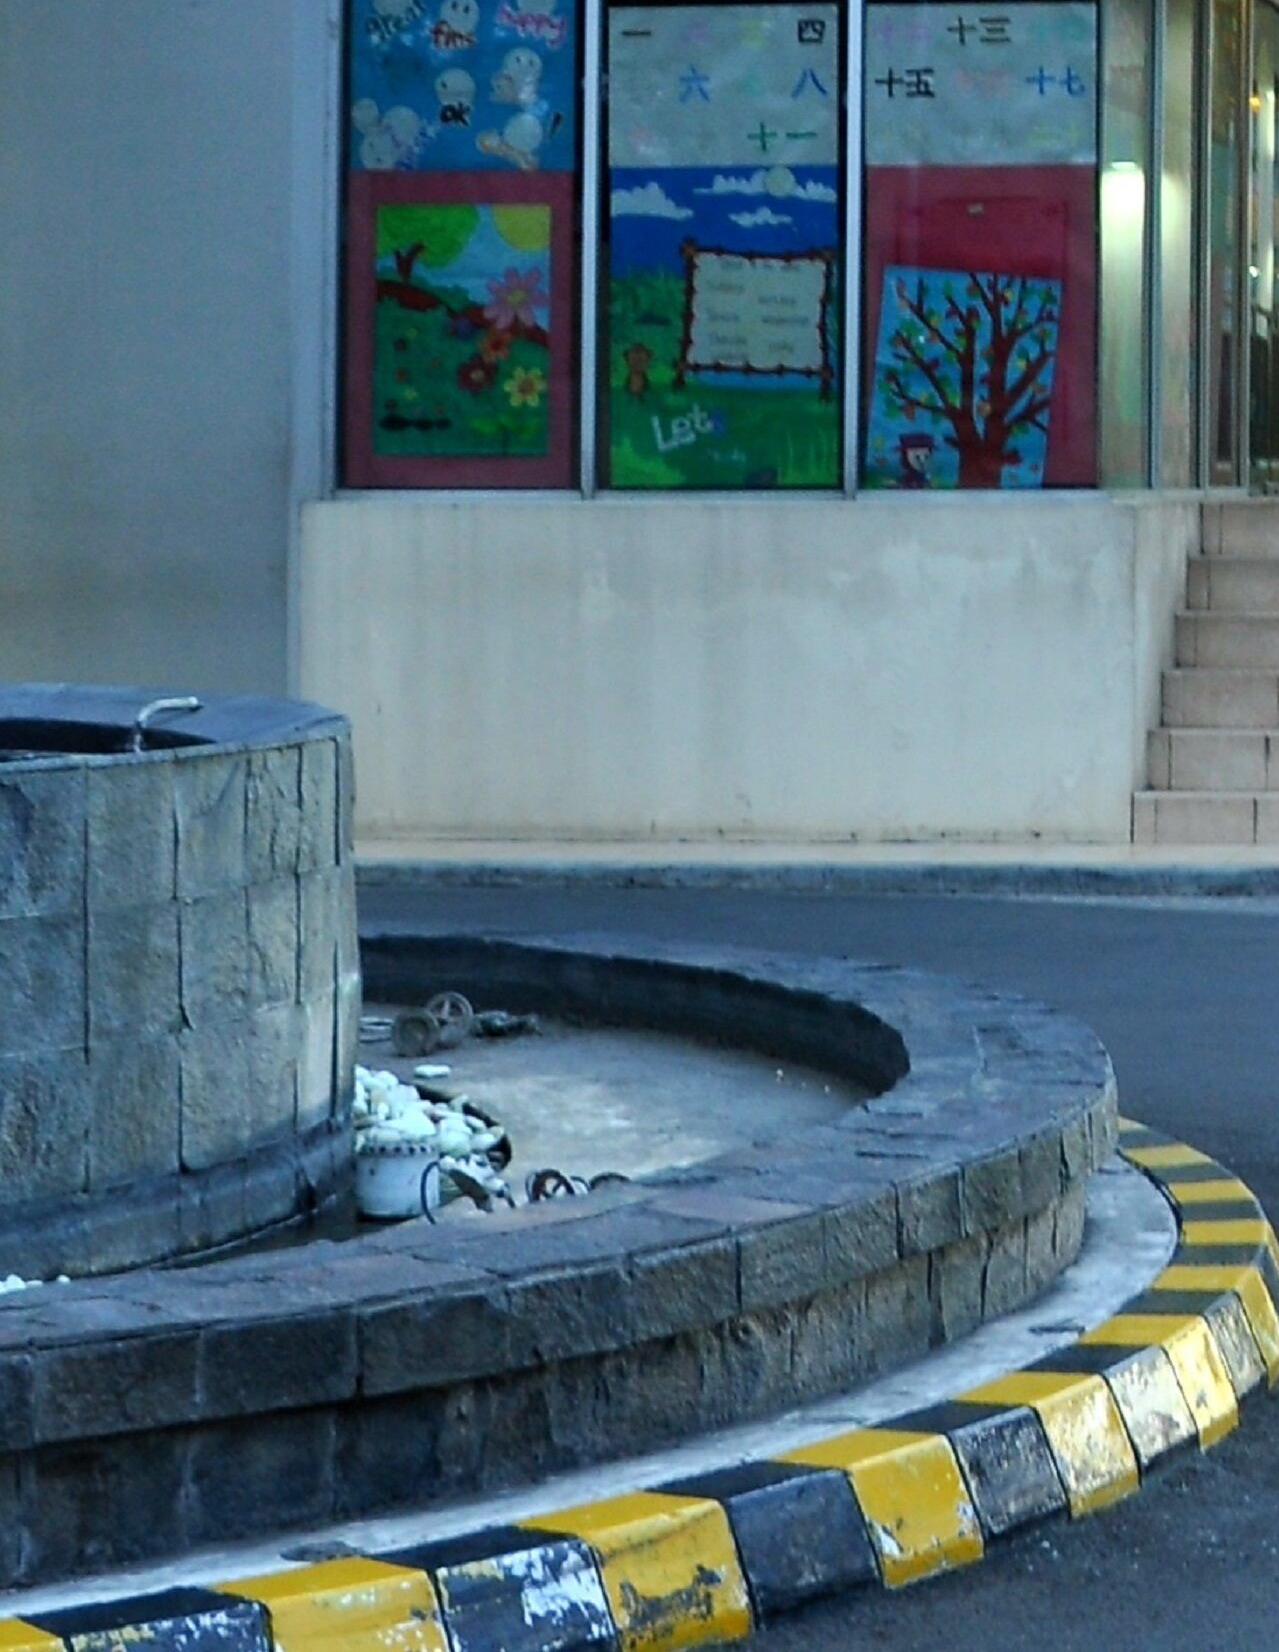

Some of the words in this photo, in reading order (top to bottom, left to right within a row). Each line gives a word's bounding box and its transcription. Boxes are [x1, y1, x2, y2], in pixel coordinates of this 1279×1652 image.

[797, 18, 827, 44] 四
[946, 15, 1012, 46] 十三
[678, 62, 711, 103] 六
[874, 66, 936, 98] 十五
[1024, 64, 1087, 96] 十七
[747, 122, 818, 151] 十一
